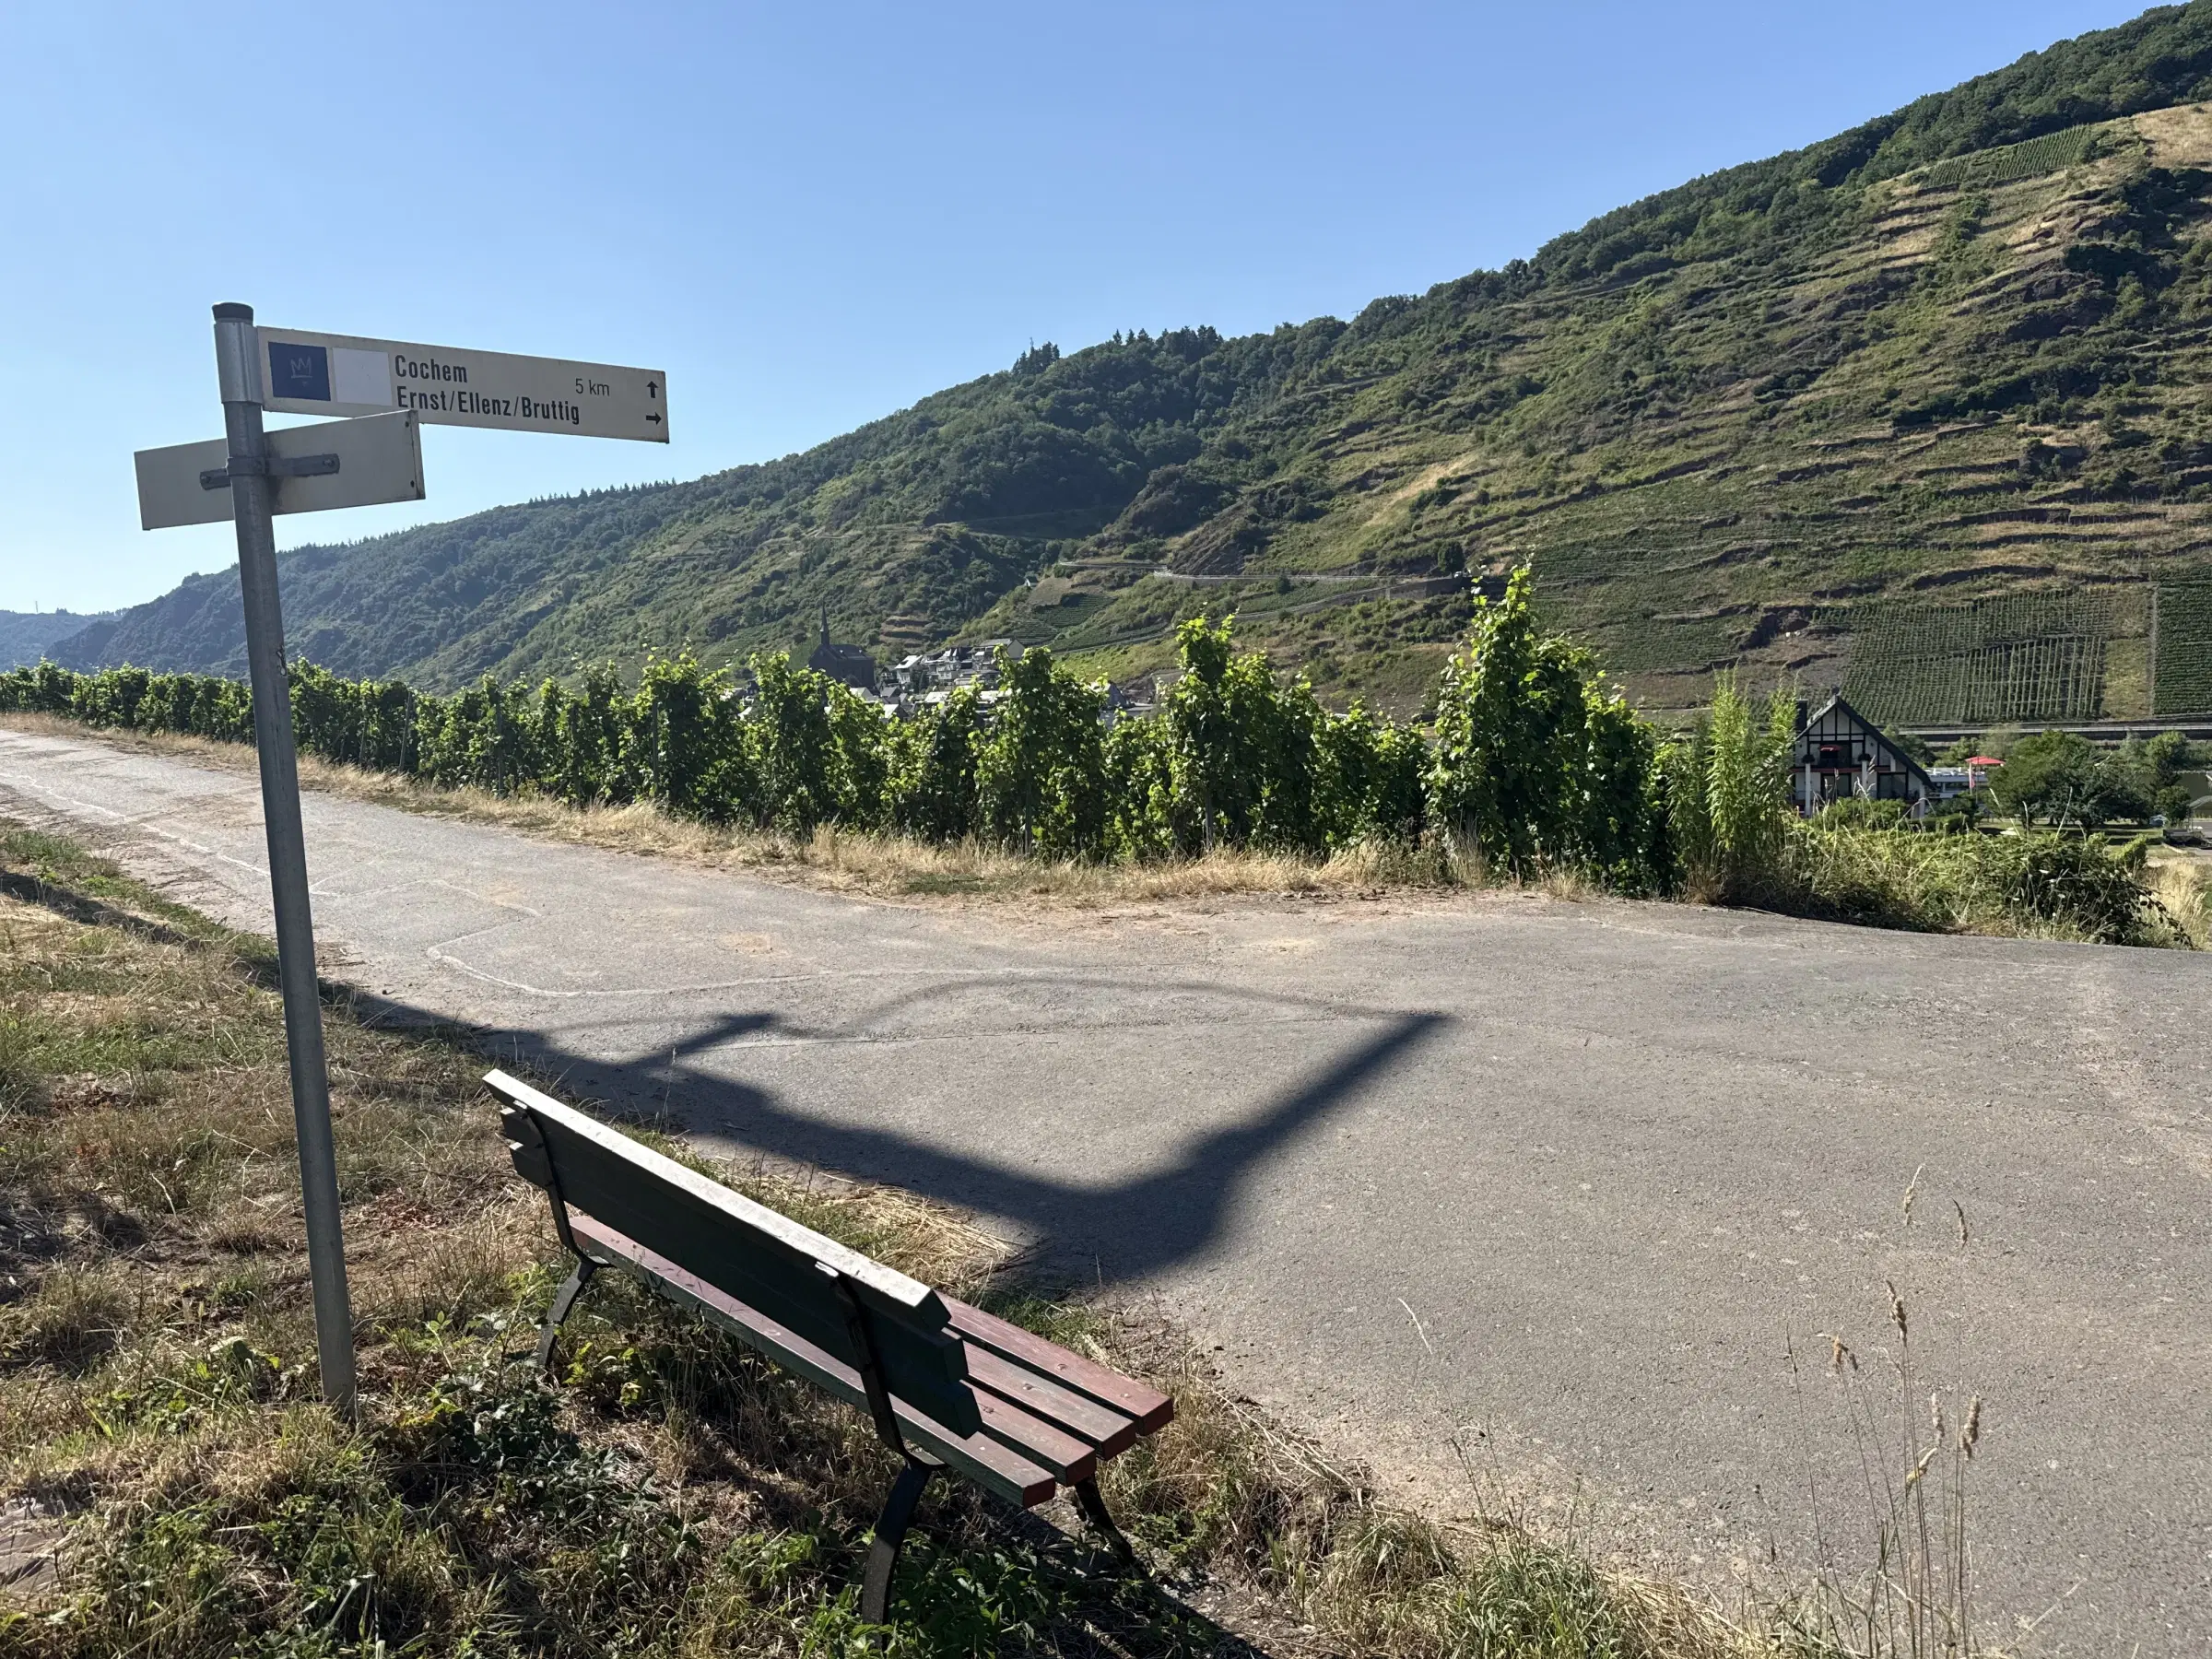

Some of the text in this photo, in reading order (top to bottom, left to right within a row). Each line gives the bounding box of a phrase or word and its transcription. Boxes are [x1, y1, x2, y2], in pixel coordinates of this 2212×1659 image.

[394, 354, 610, 396] Cochem 5 km
[396, 385, 580, 425] Ernst/Ellenz/Bruttig
